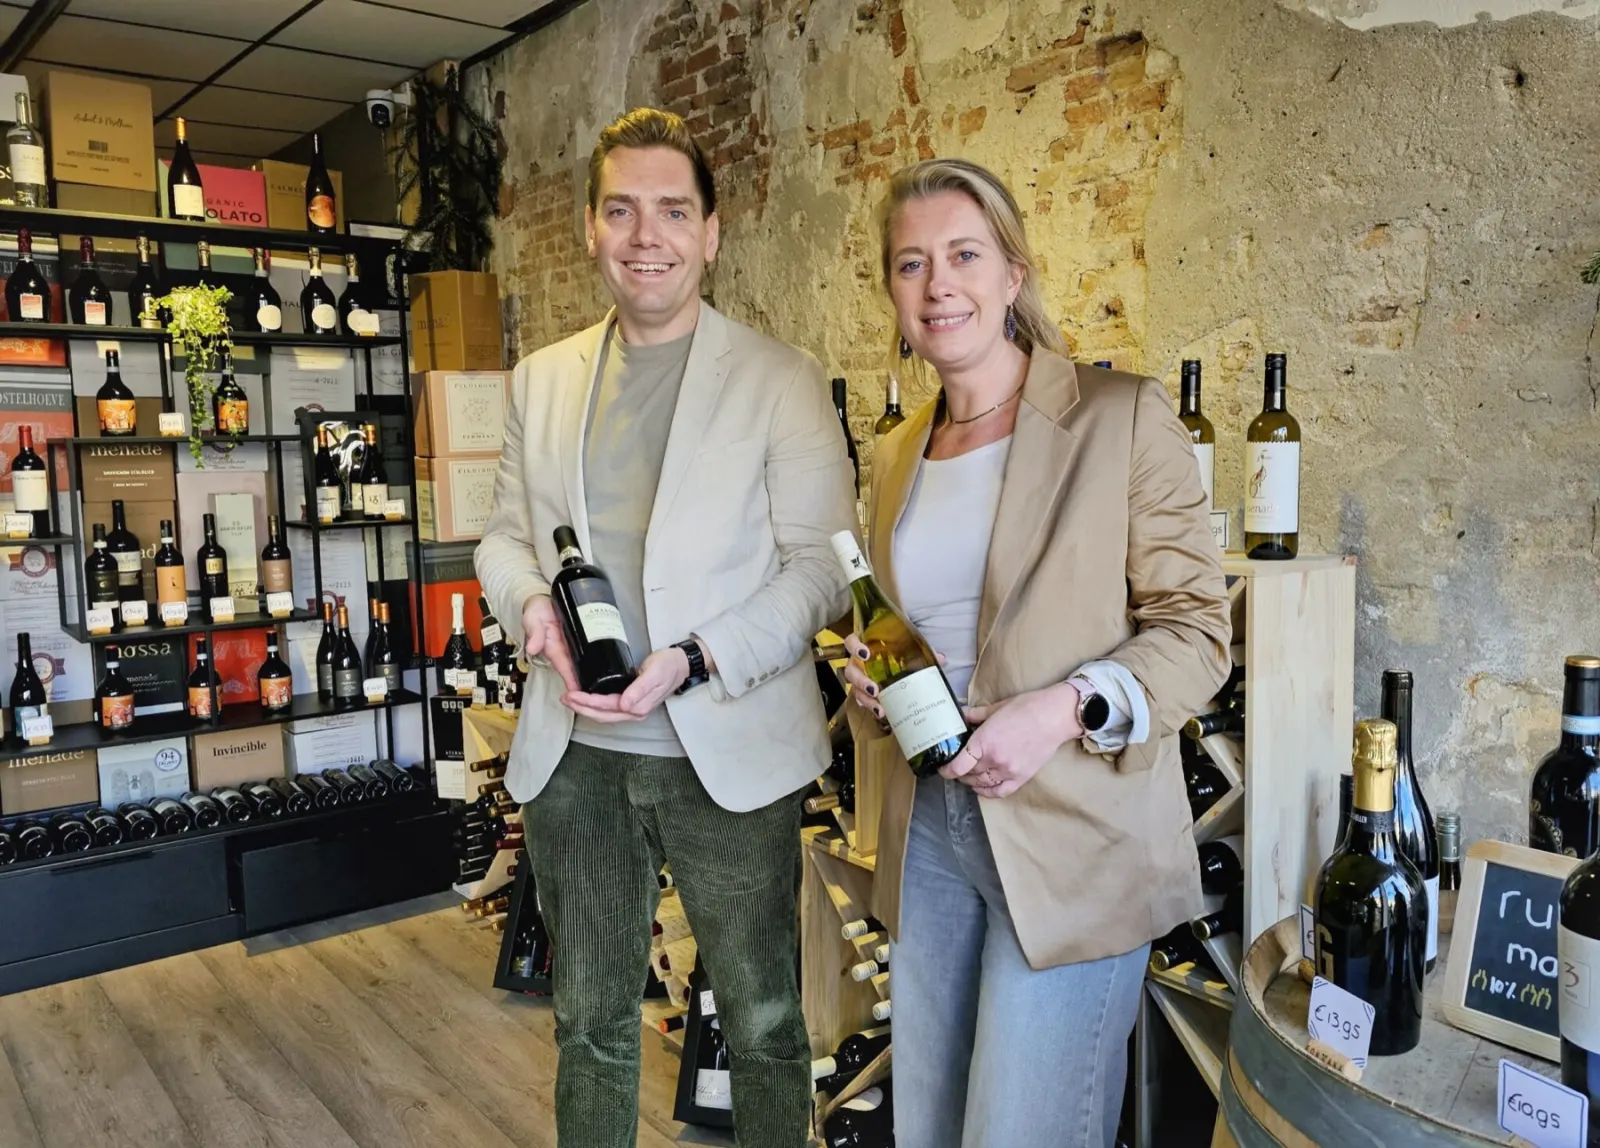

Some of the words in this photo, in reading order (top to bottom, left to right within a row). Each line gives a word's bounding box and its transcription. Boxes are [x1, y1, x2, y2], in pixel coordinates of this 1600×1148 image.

[206, 198, 245, 208] GANIC
[206, 208, 262, 223] OLATO
[0, 392, 65, 407] STELHOEVE
[160, 751, 175, 761] 94
[213, 740, 267, 757] Invincible
[1499, 890, 1554, 930] ru
[1489, 976, 1516, 1000] 10%
